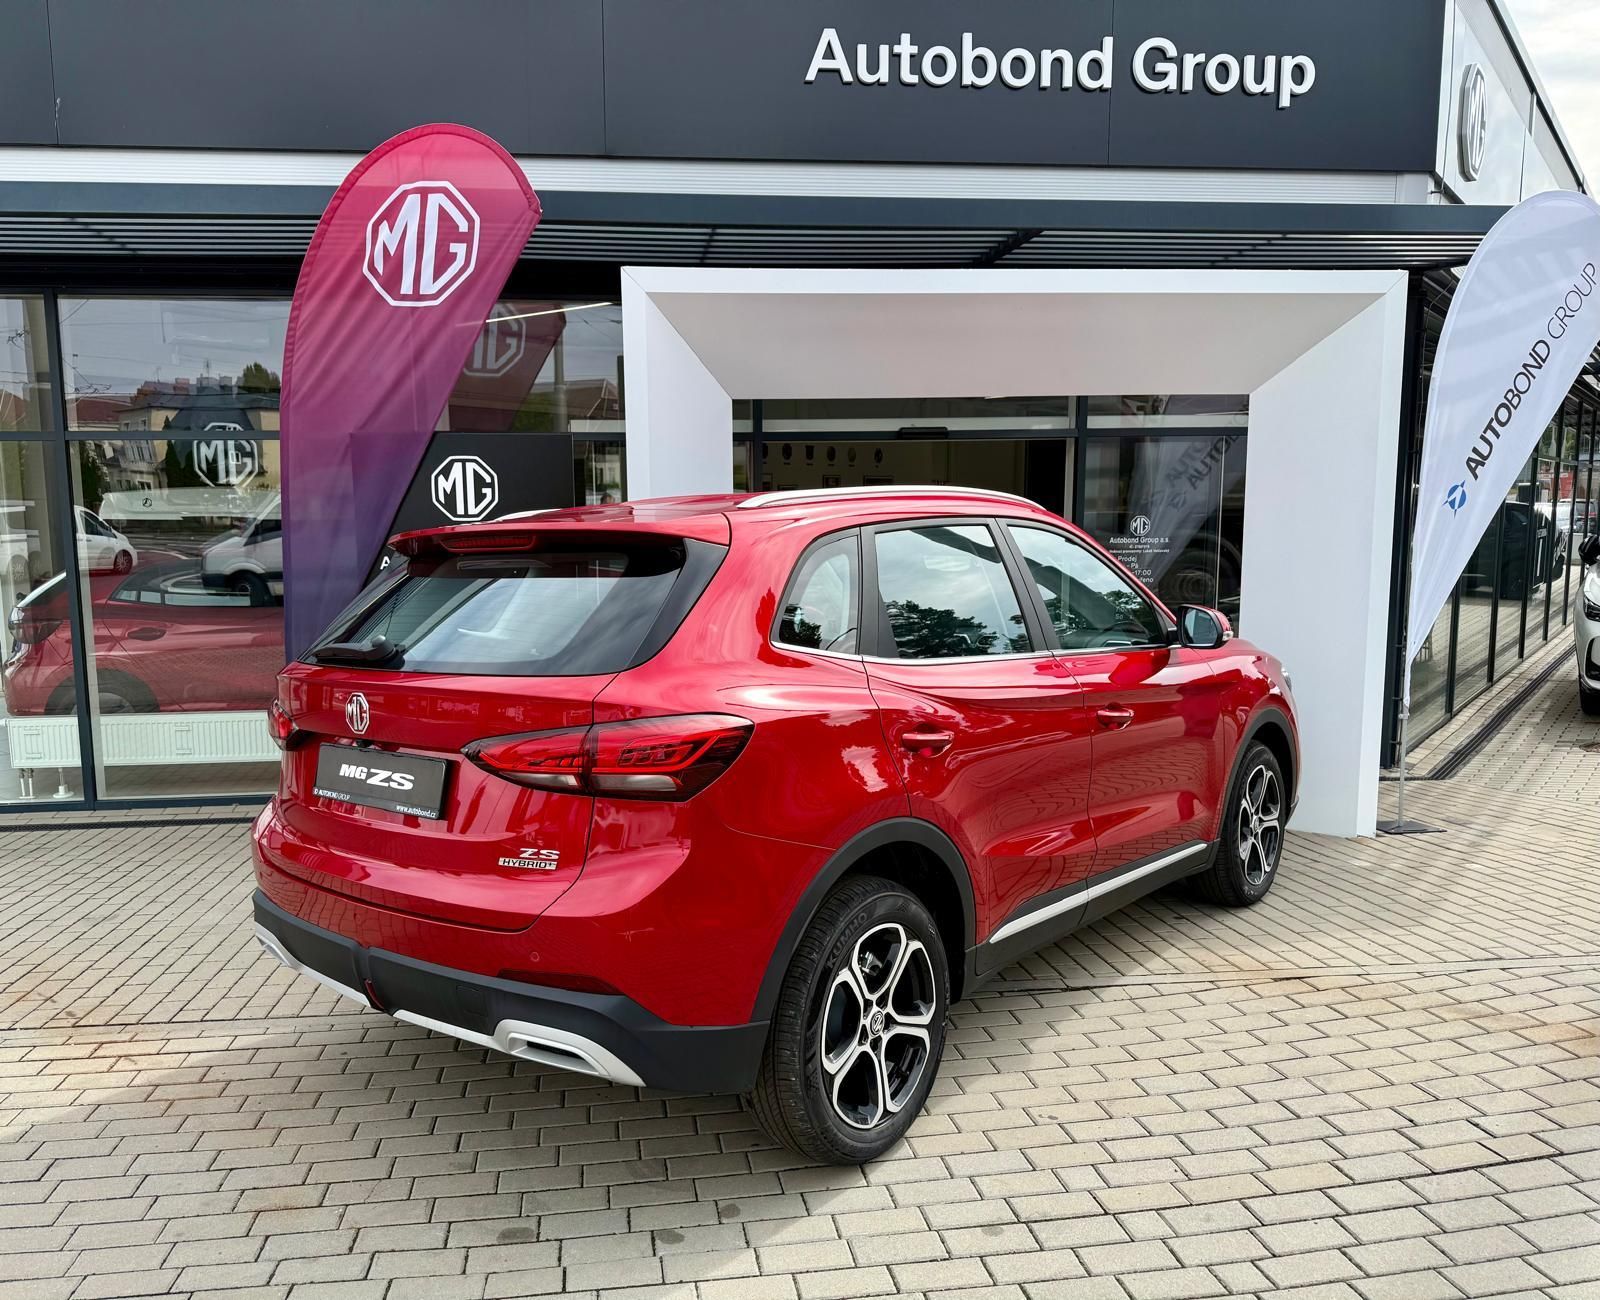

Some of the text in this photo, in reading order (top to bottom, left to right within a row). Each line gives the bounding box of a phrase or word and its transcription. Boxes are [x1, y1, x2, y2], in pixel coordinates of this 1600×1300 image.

[804, 28, 1316, 109] Autobond Group
[374, 193, 469, 295] MG
[1465, 261, 1598, 481] AUTOBOND GROUP
[200, 429, 252, 485] MG
[438, 461, 493, 515] MG
[1132, 517, 1149, 535] MG
[347, 696, 367, 731] MG
[396, 804, 436, 818] www.autobond.cz
[520, 848, 560, 860] ZS
[826, 912, 868, 969] KUMHO
